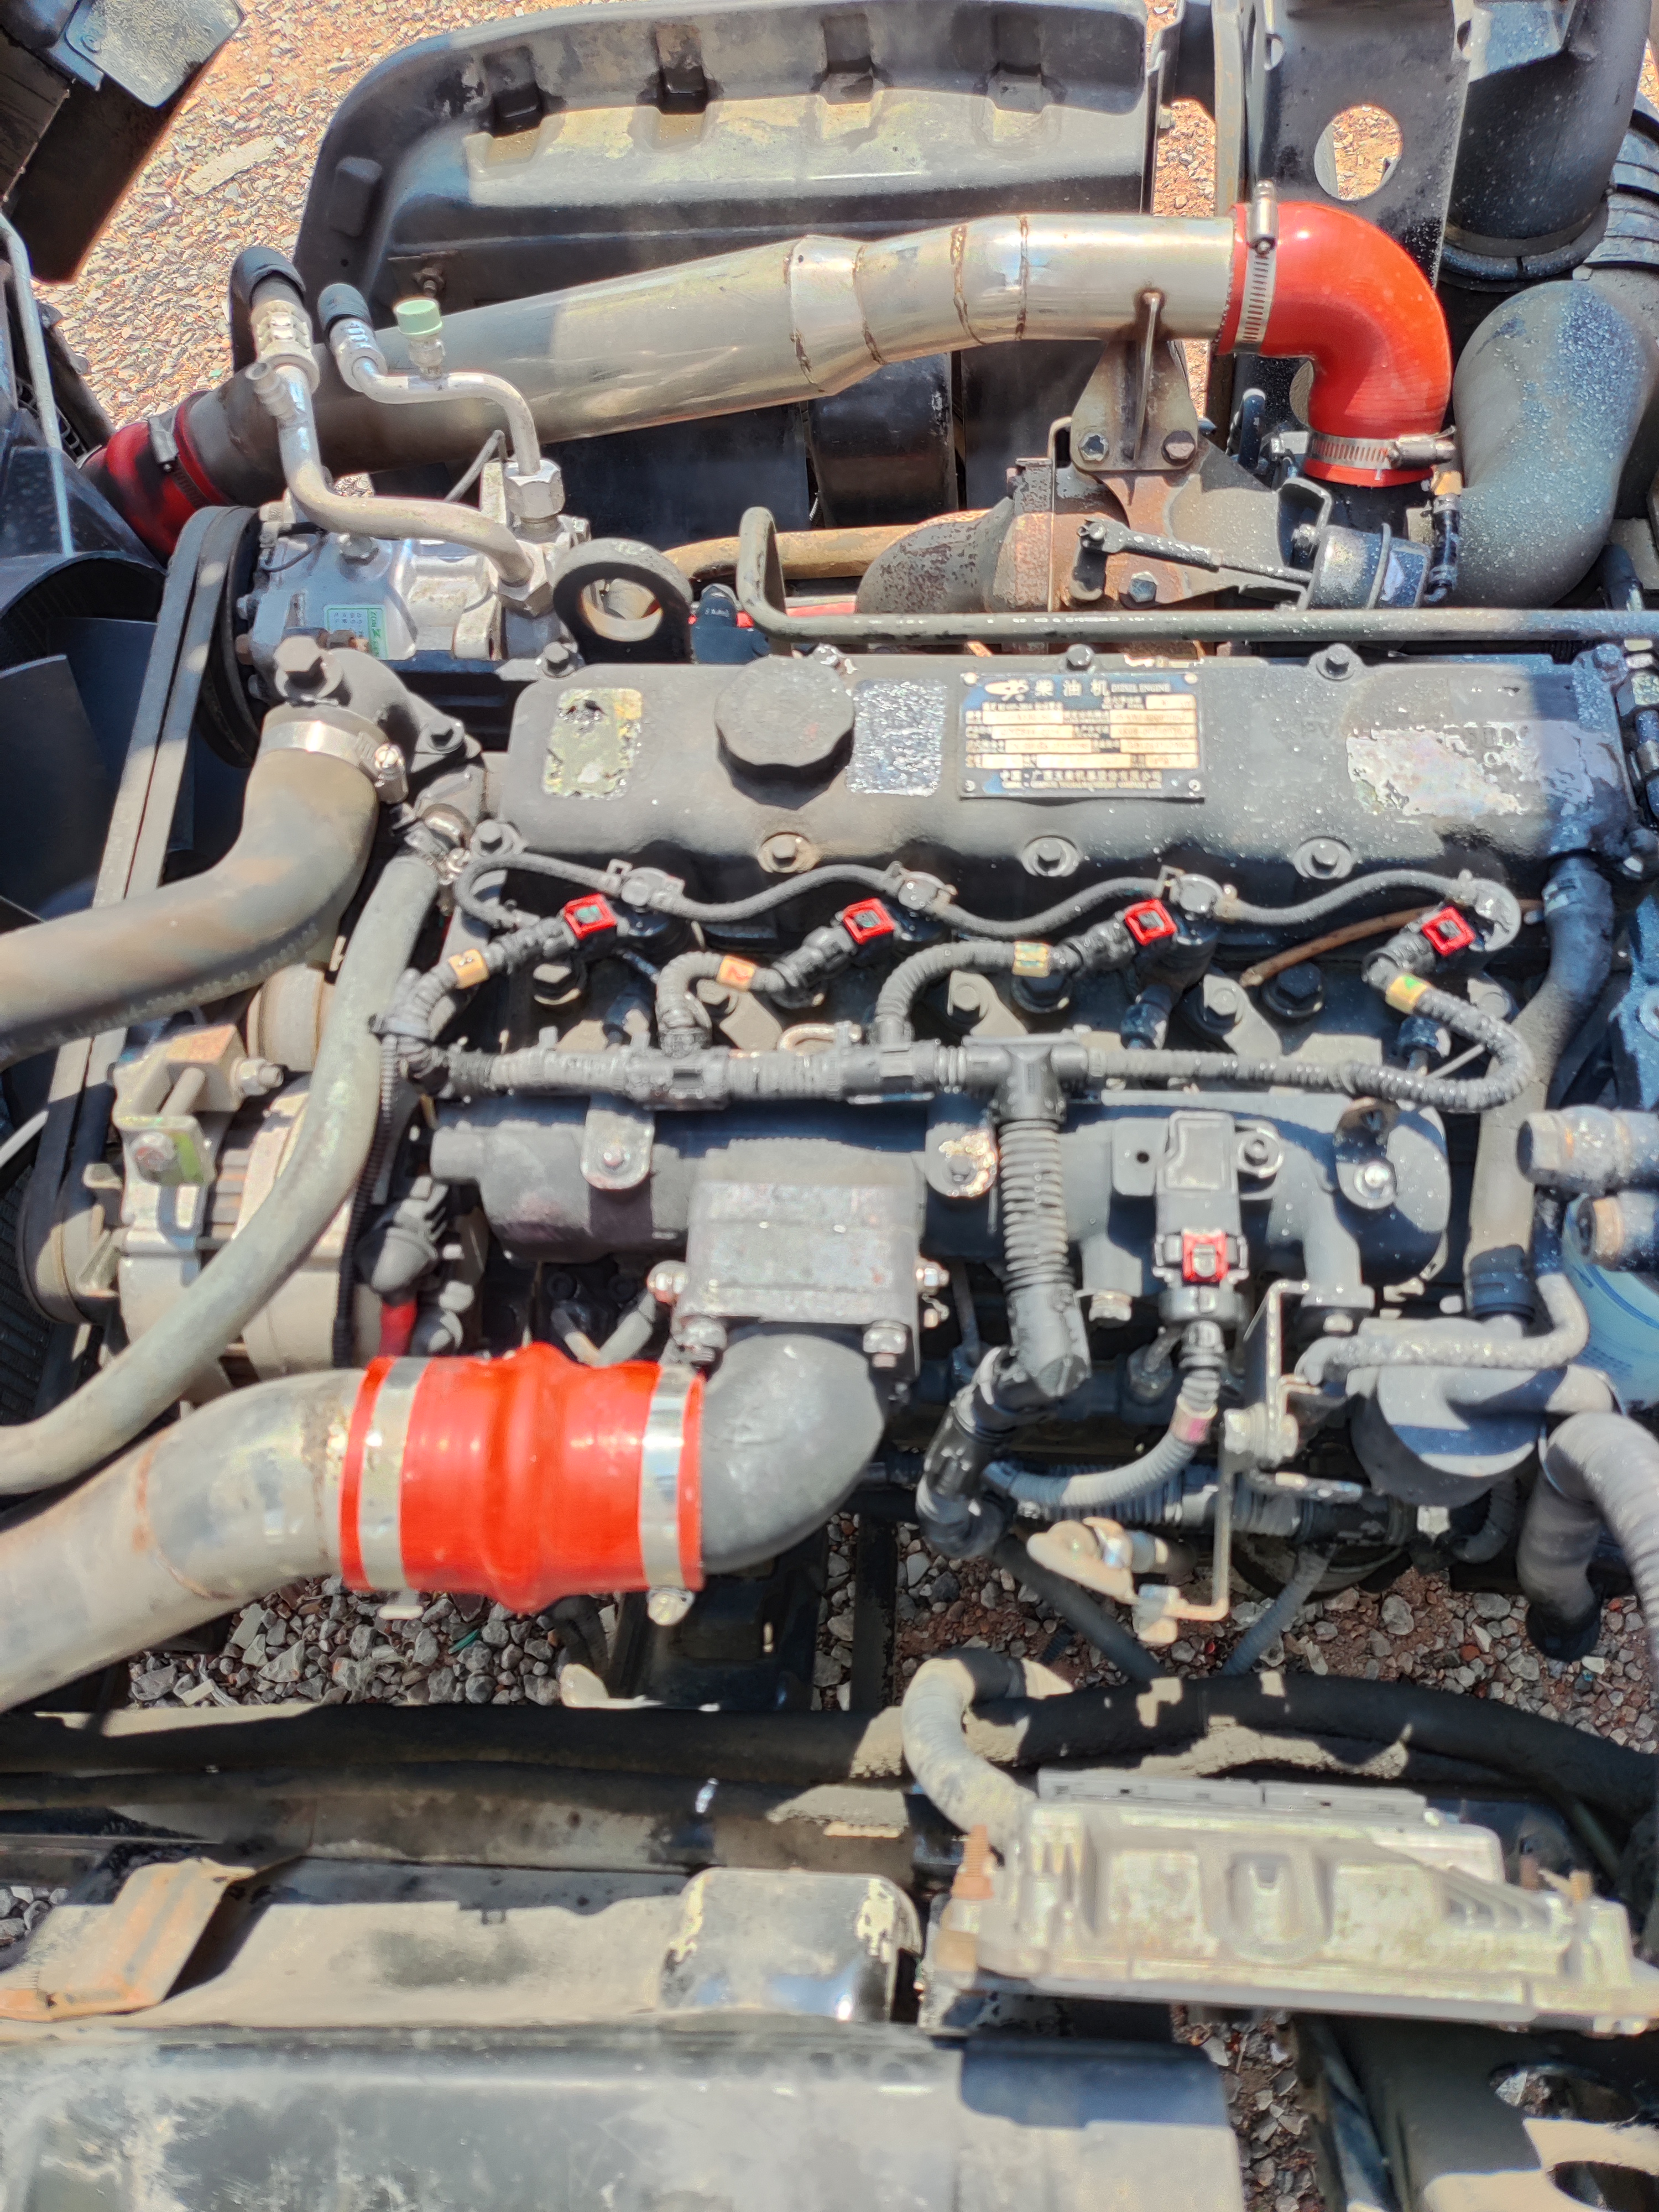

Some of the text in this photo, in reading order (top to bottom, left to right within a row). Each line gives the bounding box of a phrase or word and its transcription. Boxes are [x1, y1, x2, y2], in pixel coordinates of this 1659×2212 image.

[1035, 679, 1171, 697] 柴油机 DIESEL ENGINE
